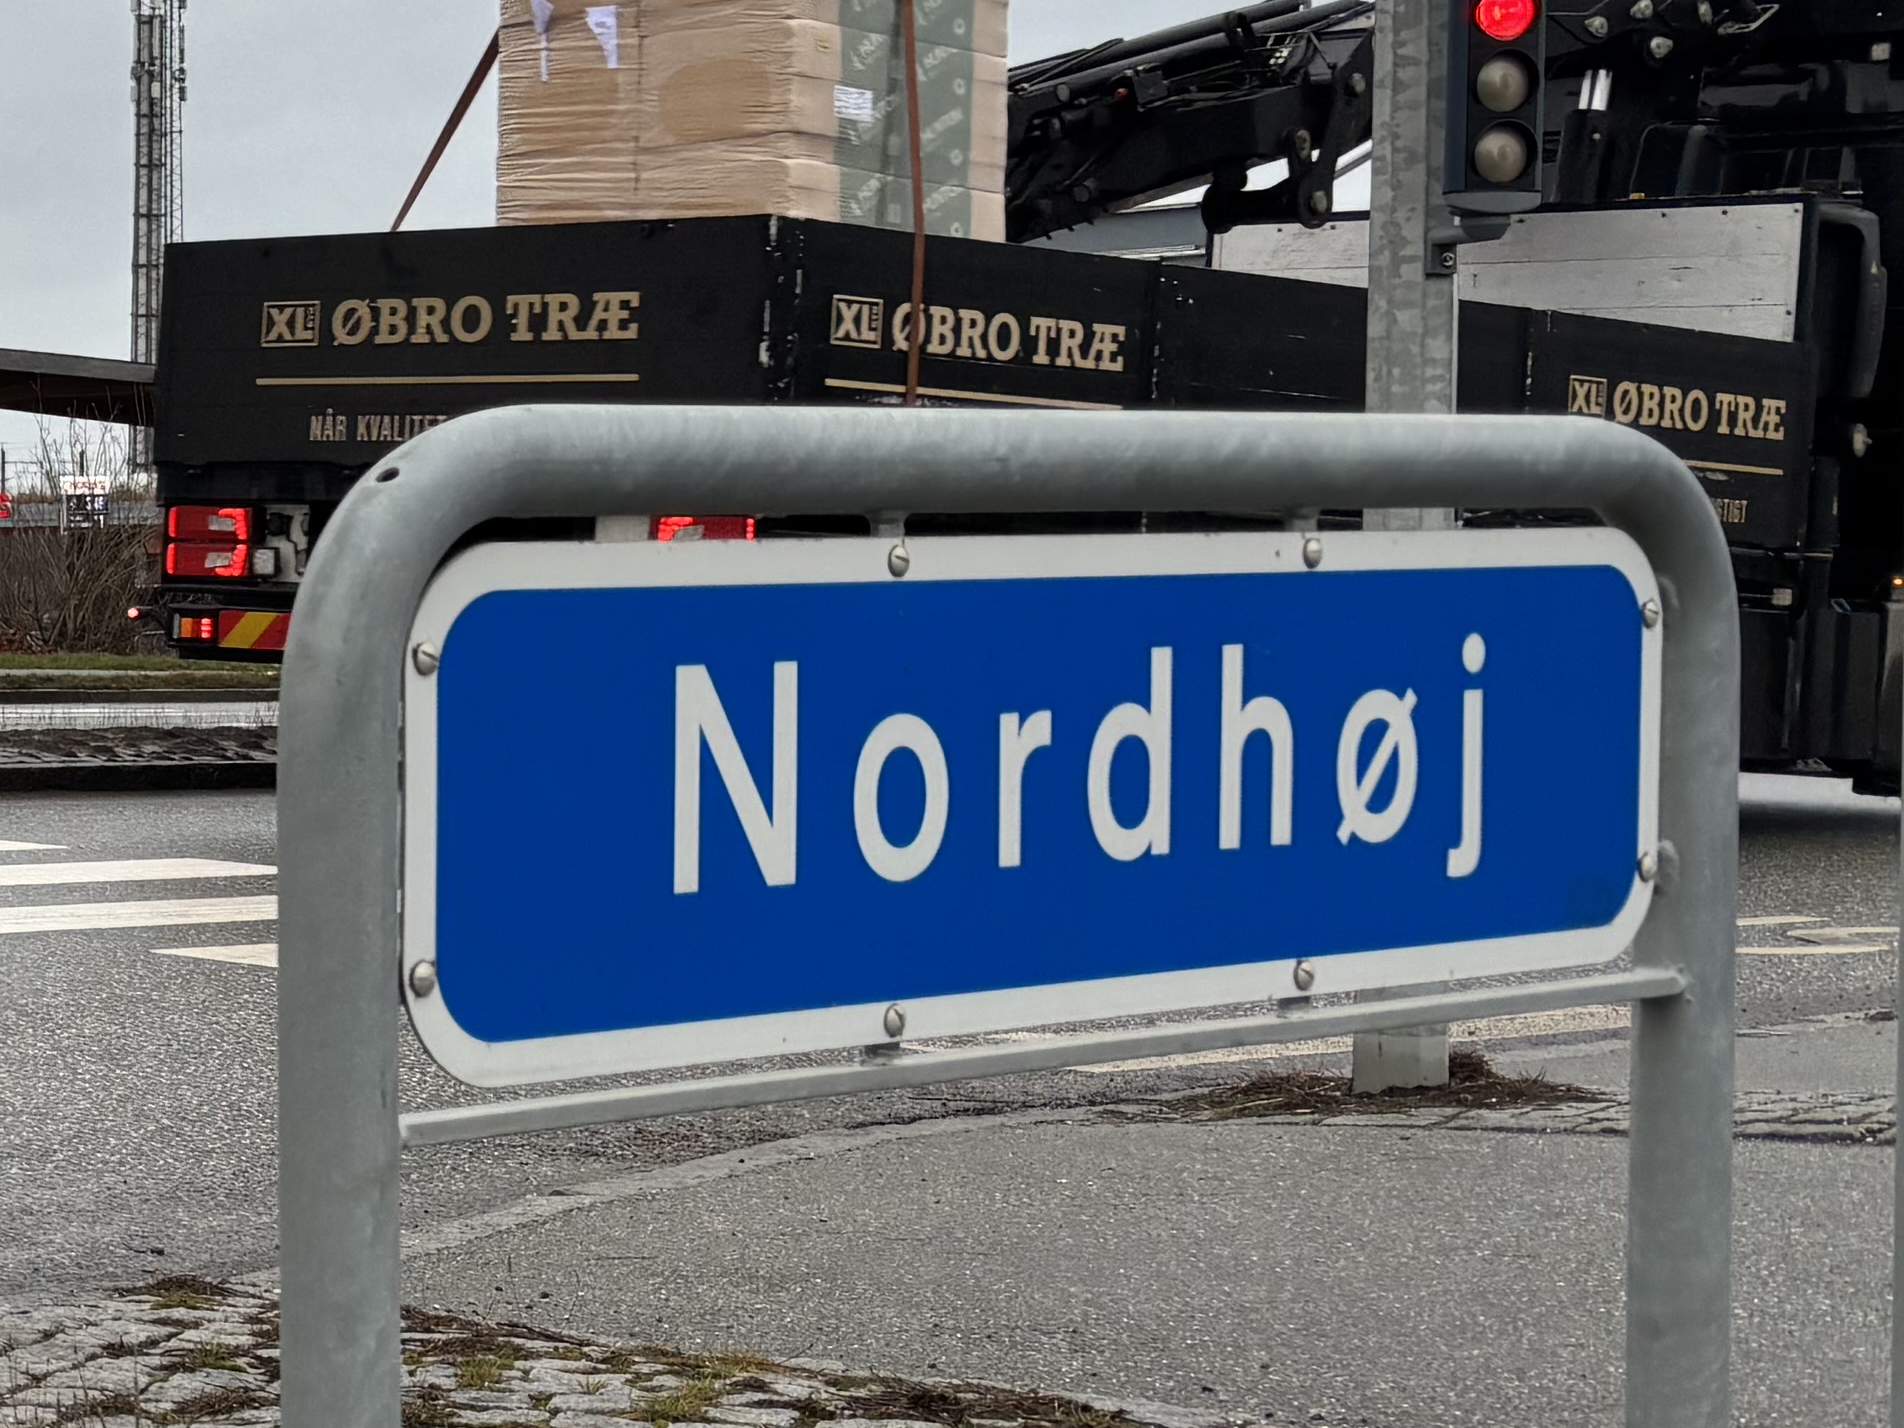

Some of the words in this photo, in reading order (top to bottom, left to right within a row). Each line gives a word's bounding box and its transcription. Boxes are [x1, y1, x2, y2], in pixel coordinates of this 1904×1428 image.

[267, 307, 315, 341] XL
[331, 295, 493, 347] ØBRO
[505, 291, 641, 342] TRÆ
[836, 302, 877, 341] XL
[892, 302, 1021, 361] ØBRO
[1029, 316, 1126, 372] TRÆ
[309, 408, 347, 441] NÅR
[356, 414, 448, 441] KVALITE
[1572, 380, 1603, 415] XL
[1613, 380, 1709, 432] ØBRO
[1715, 392, 1787, 441] TRÆ
[672, 631, 1488, 896] Nordhøj
